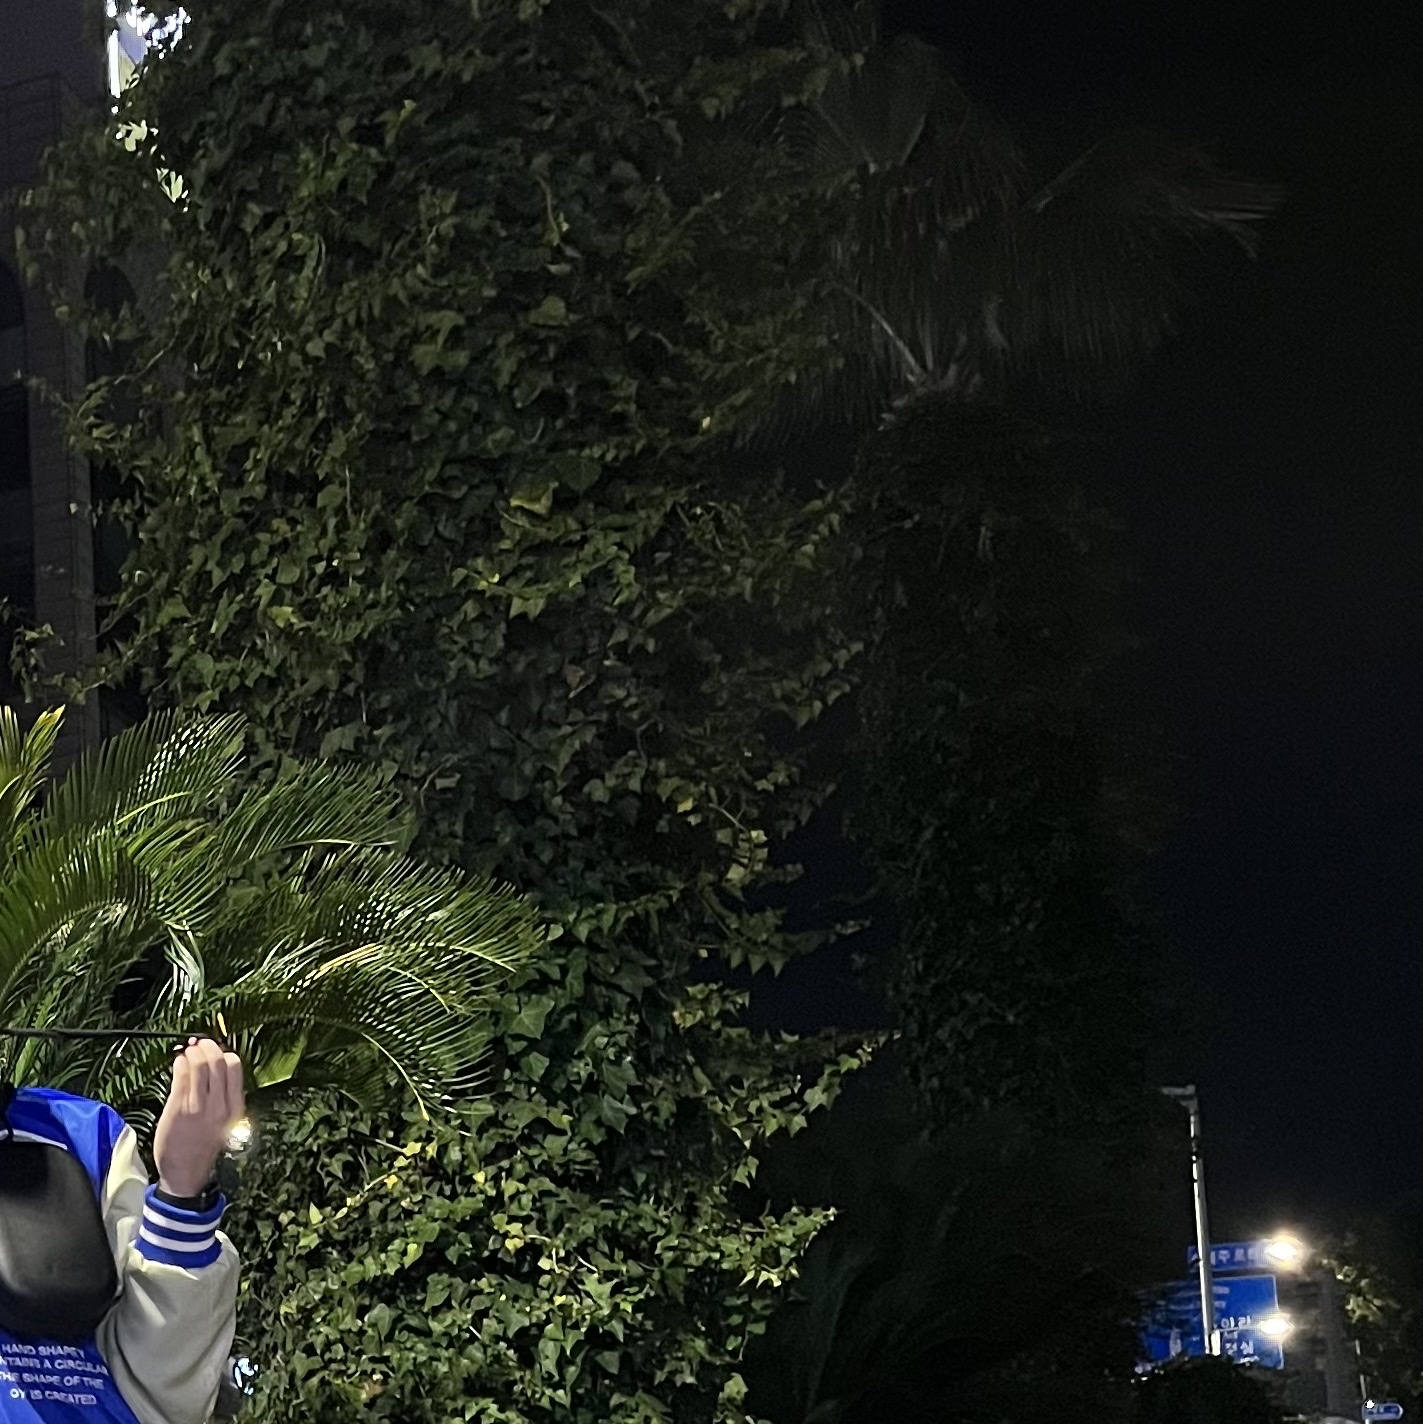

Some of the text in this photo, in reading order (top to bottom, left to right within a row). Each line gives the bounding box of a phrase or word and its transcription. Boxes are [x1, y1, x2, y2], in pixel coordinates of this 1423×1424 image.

[43, 1359, 52, 1369] A
[22, 1373, 61, 1385] SHAPE
[63, 1376, 80, 1386] OF
[82, 1377, 104, 1389] THE
[45, 1391, 97, 1405] CREATED
